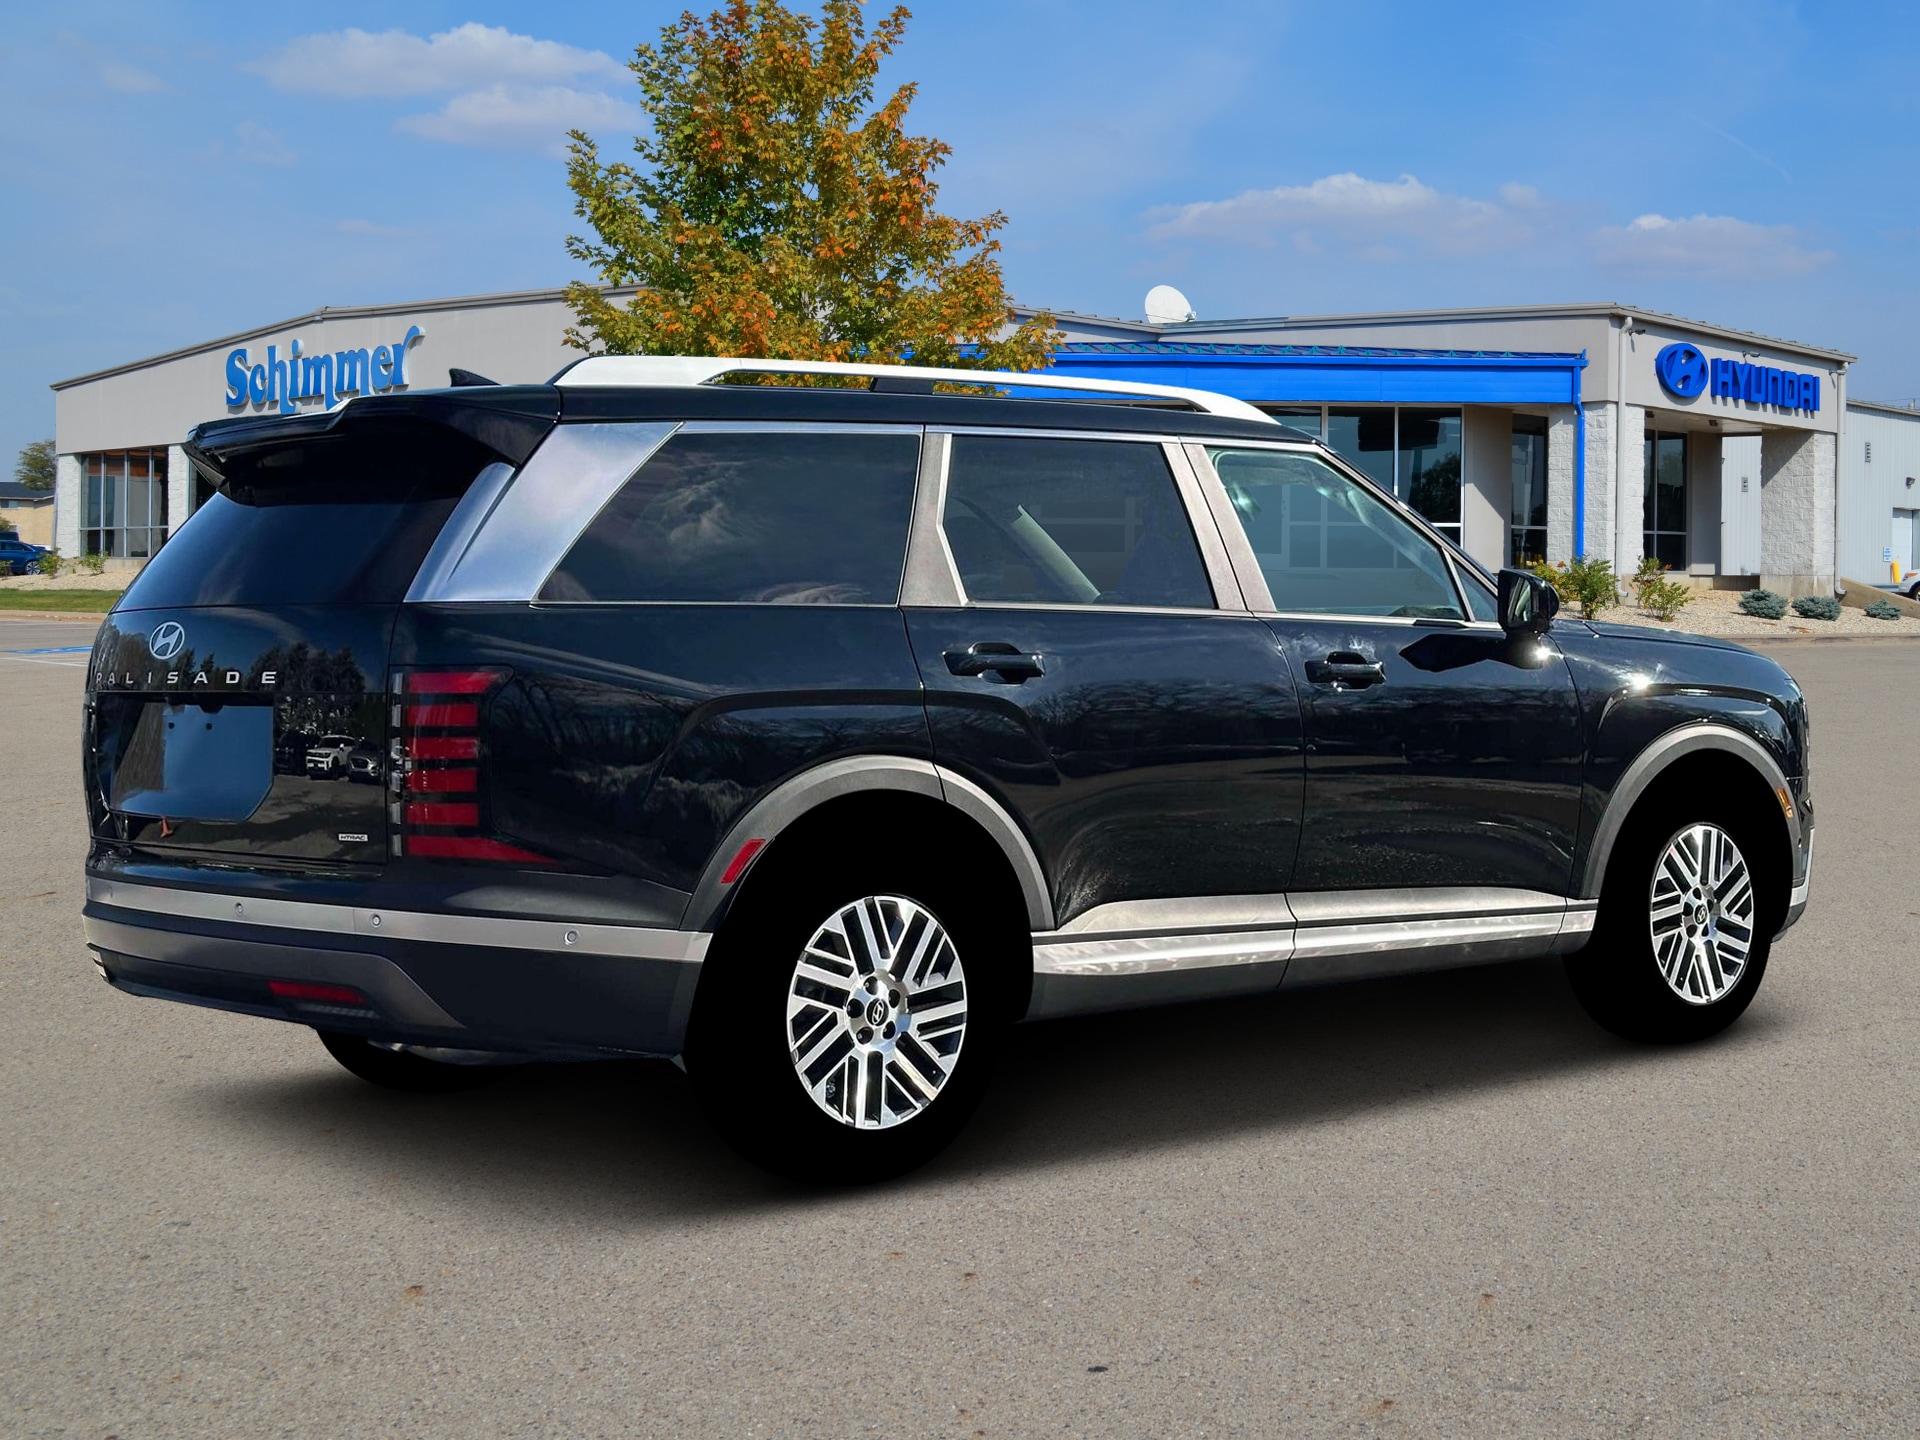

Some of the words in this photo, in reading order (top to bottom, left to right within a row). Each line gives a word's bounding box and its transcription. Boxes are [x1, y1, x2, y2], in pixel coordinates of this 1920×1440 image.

[226, 325, 425, 414] Schimmer
[1711, 358, 1820, 411] HYUNDAI
[96, 671, 277, 684] PALISADE
